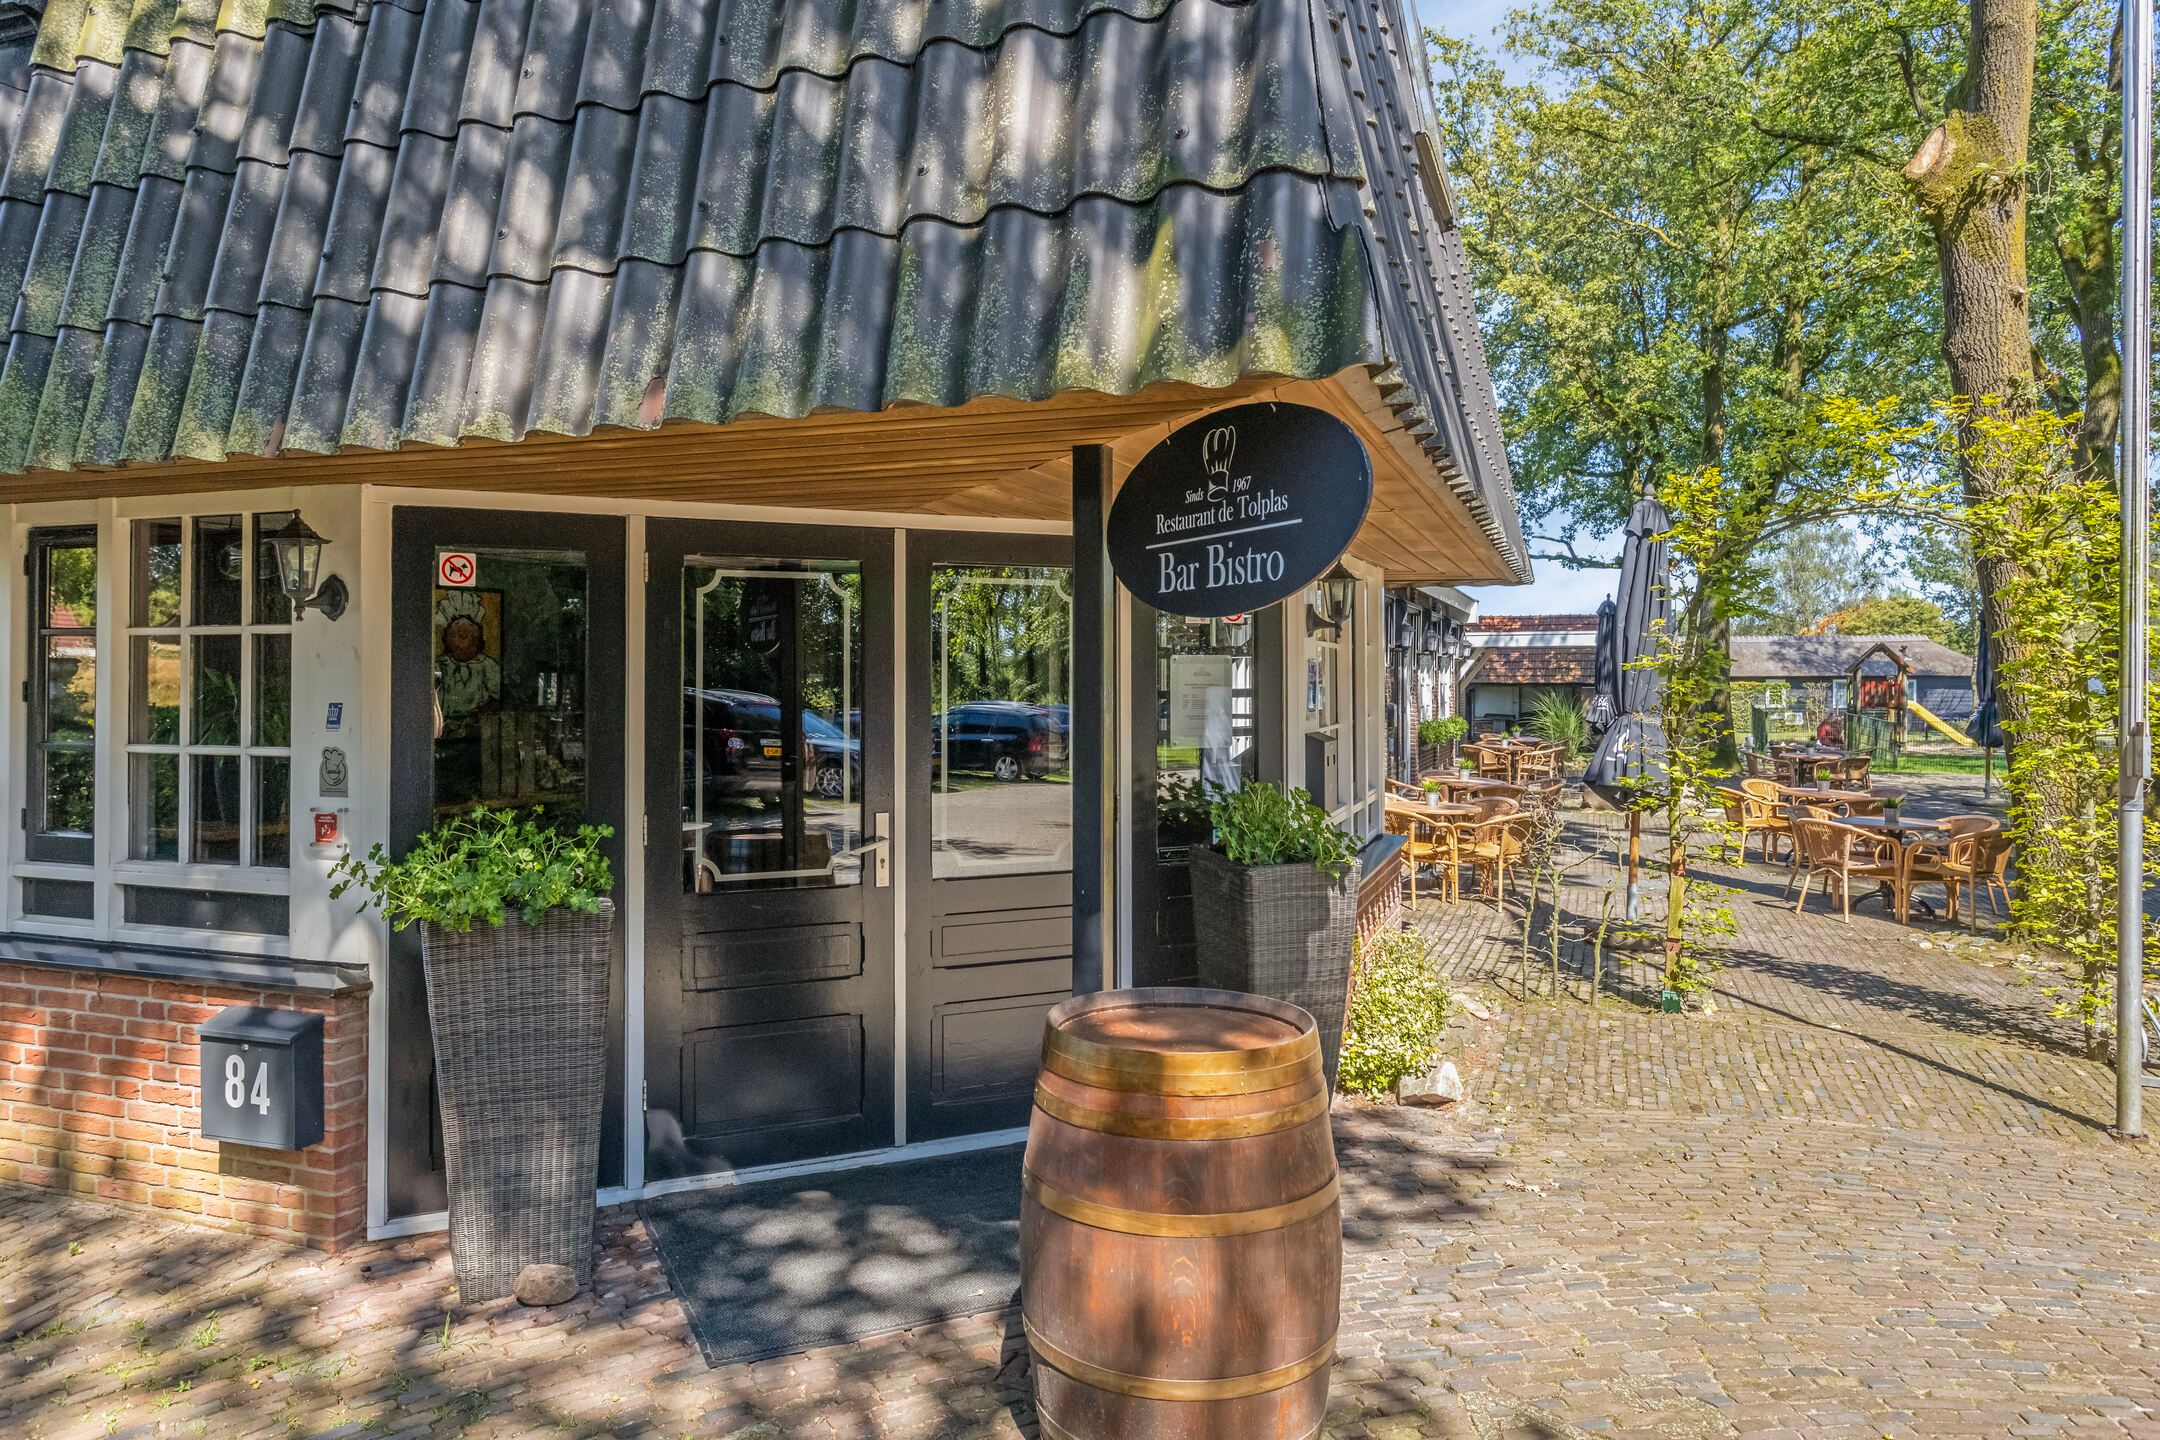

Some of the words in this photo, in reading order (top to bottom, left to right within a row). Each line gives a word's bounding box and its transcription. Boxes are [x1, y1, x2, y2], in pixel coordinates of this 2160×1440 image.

[1156, 505, 1216, 535] Restaurant
[1218, 500, 1234, 523] de
[1237, 489, 1288, 520] Tolplas
[1185, 488, 1204, 503] Sinds
[1232, 476, 1251, 493] 1967
[1158, 552, 1199, 593] Bar
[1206, 541, 1285, 588] Bistro
[225, 1054, 270, 1115] 84
